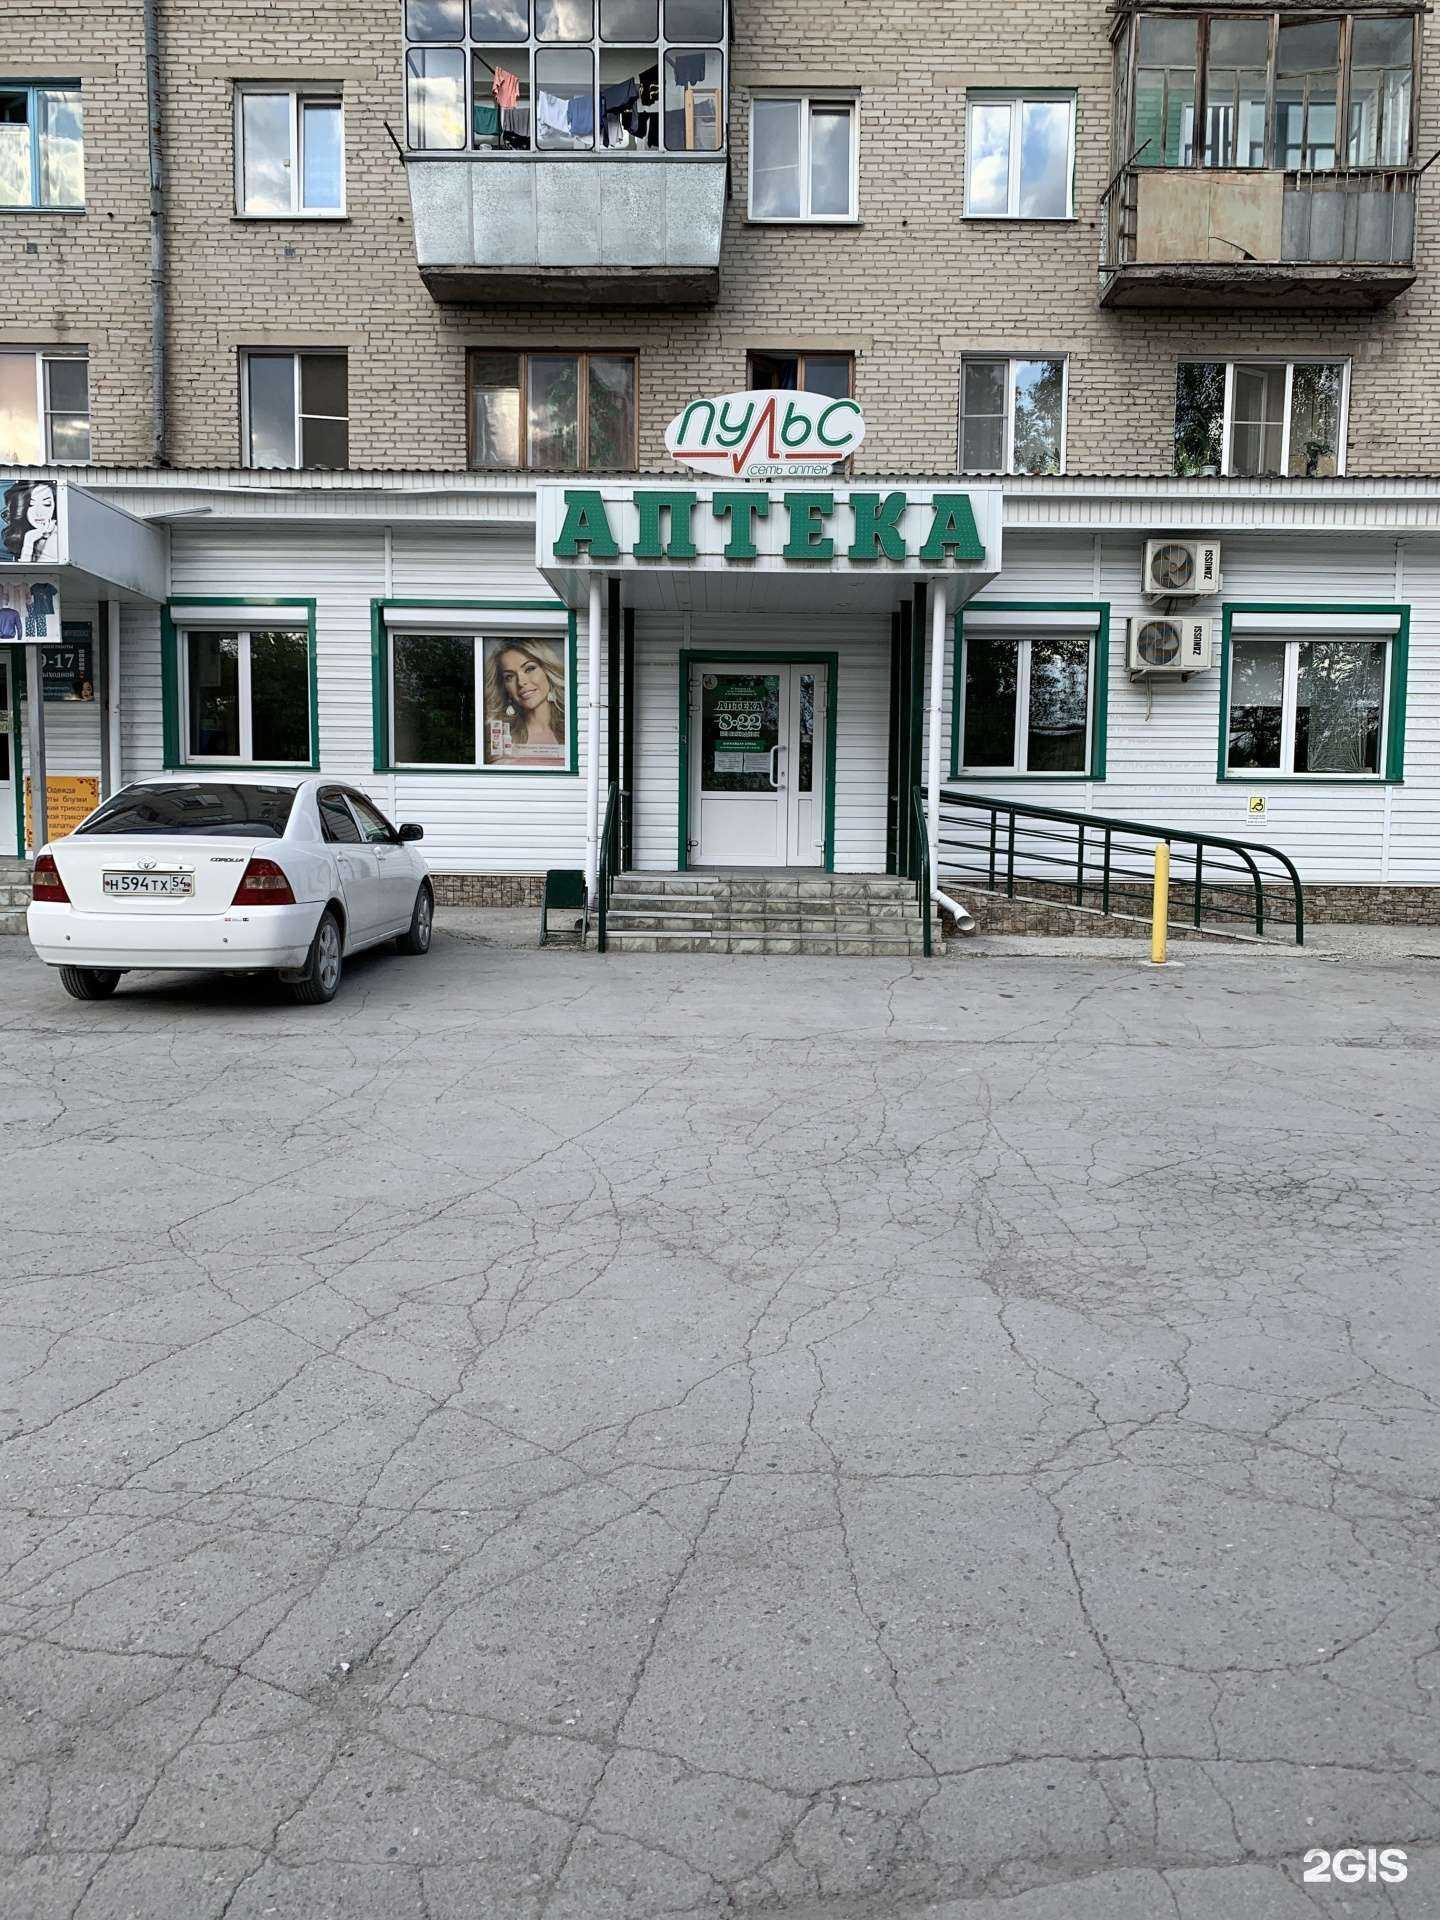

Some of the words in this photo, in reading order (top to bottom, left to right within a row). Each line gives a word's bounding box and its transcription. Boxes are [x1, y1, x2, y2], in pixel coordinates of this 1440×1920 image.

[749, 463, 783, 475] сеть
[789, 463, 830, 475] аптек
[552, 490, 986, 561] АПТЕКА
[1203, 549, 1214, 580] ZANUSSI
[1192, 625, 1203, 656] ZANUSSI
